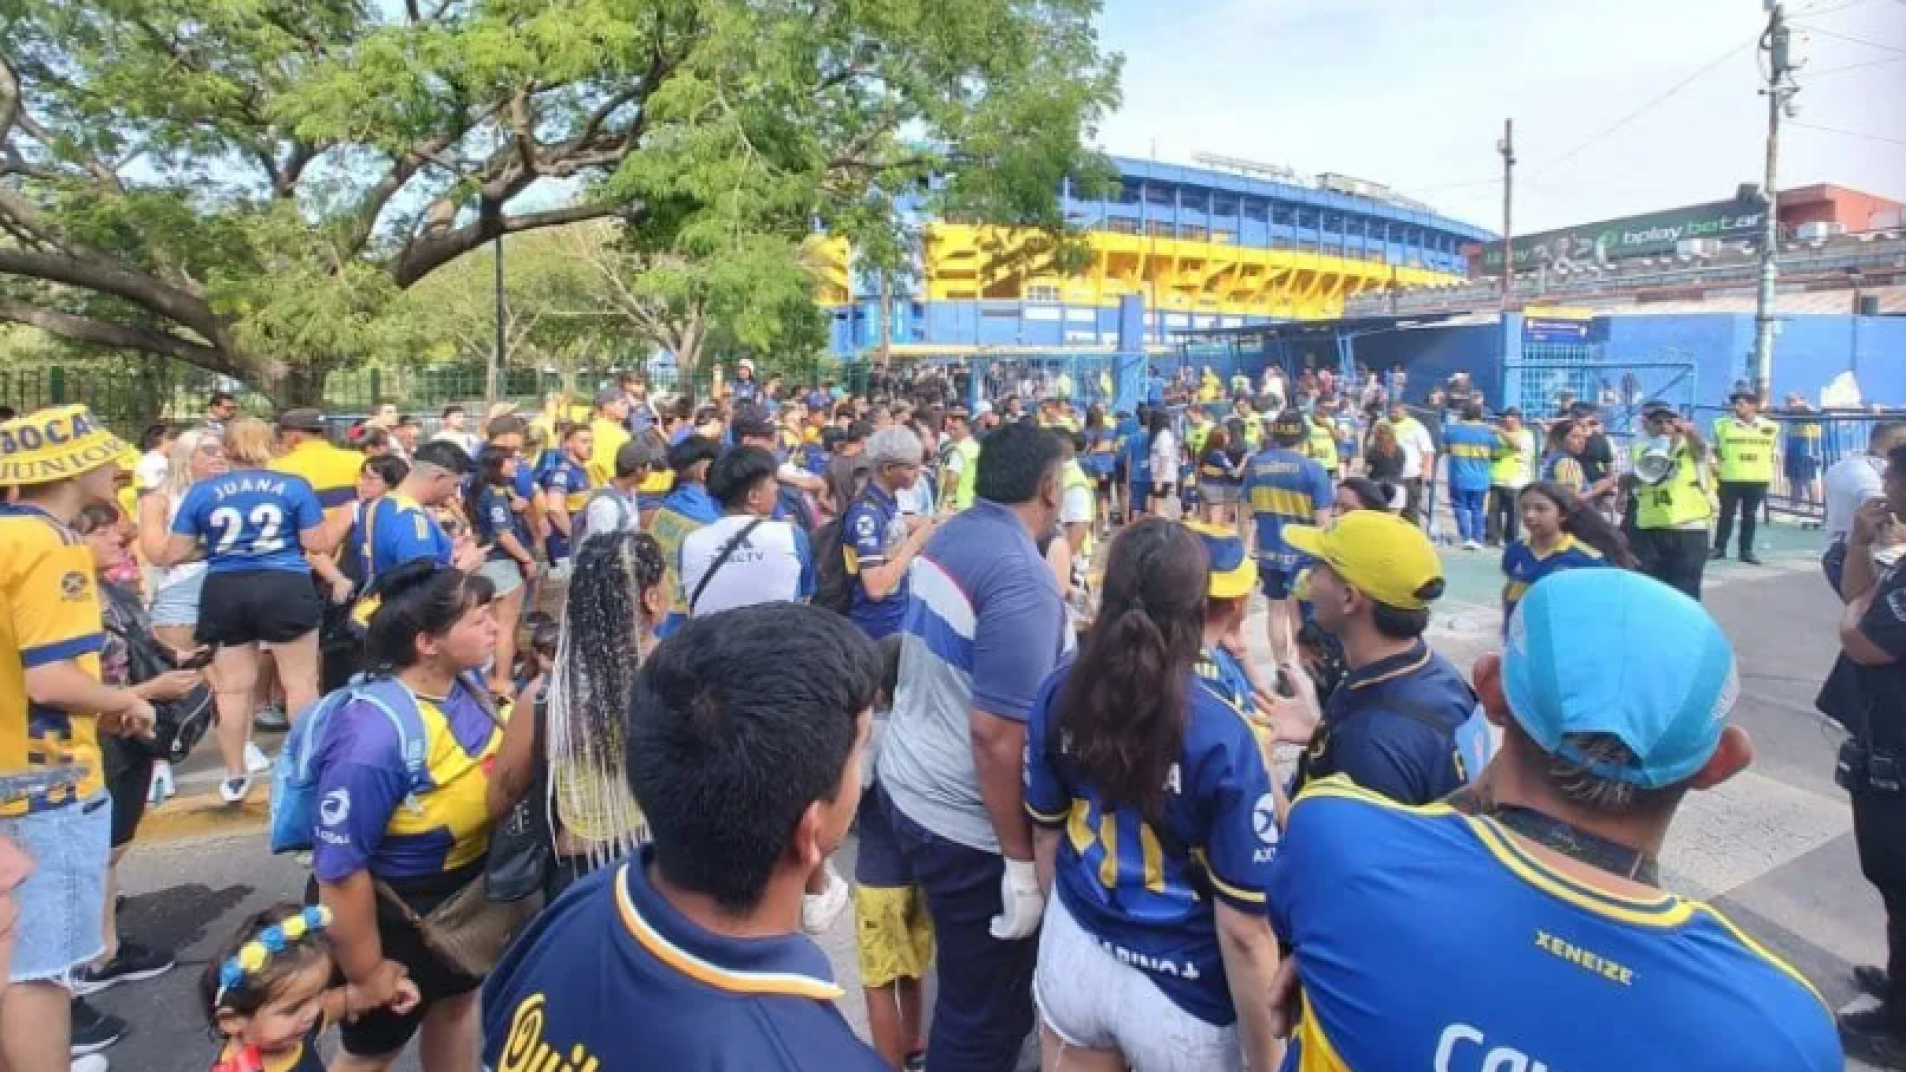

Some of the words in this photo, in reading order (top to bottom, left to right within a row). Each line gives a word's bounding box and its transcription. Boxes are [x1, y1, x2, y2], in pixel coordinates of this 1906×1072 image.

[214, 477, 286, 501] JUANA
[209, 502, 285, 557] 22
[1534, 929, 1634, 986] XENEIZE
